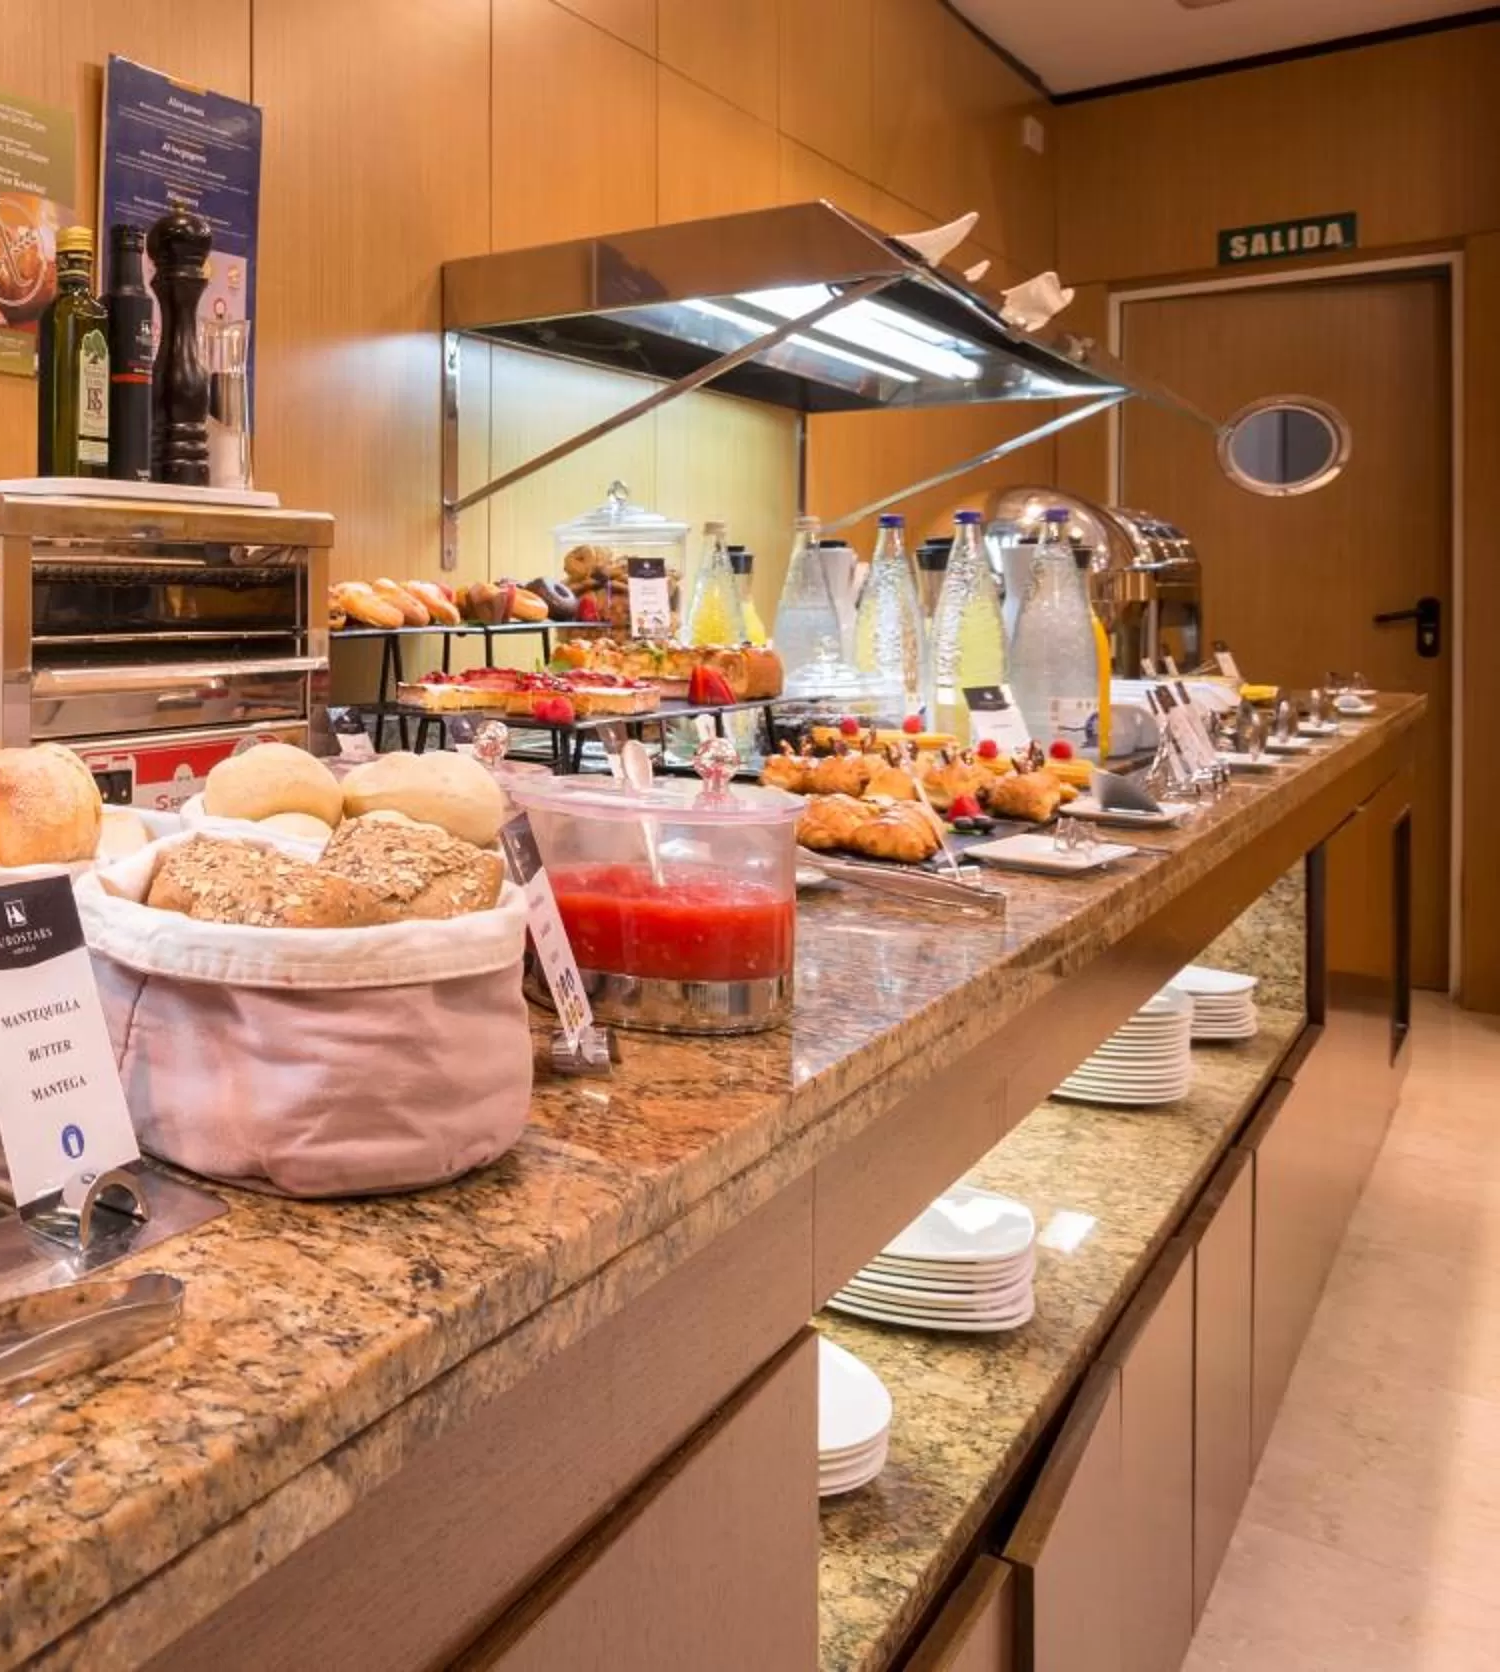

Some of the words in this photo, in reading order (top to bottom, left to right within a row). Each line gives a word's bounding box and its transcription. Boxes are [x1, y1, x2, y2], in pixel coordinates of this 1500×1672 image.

[1229, 222, 1344, 260] SALIDA
[1, 998, 81, 1029] MANTEQUILLA
[28, 1039, 74, 1062] BUTTER
[31, 1075, 88, 1102] MANTEGA
